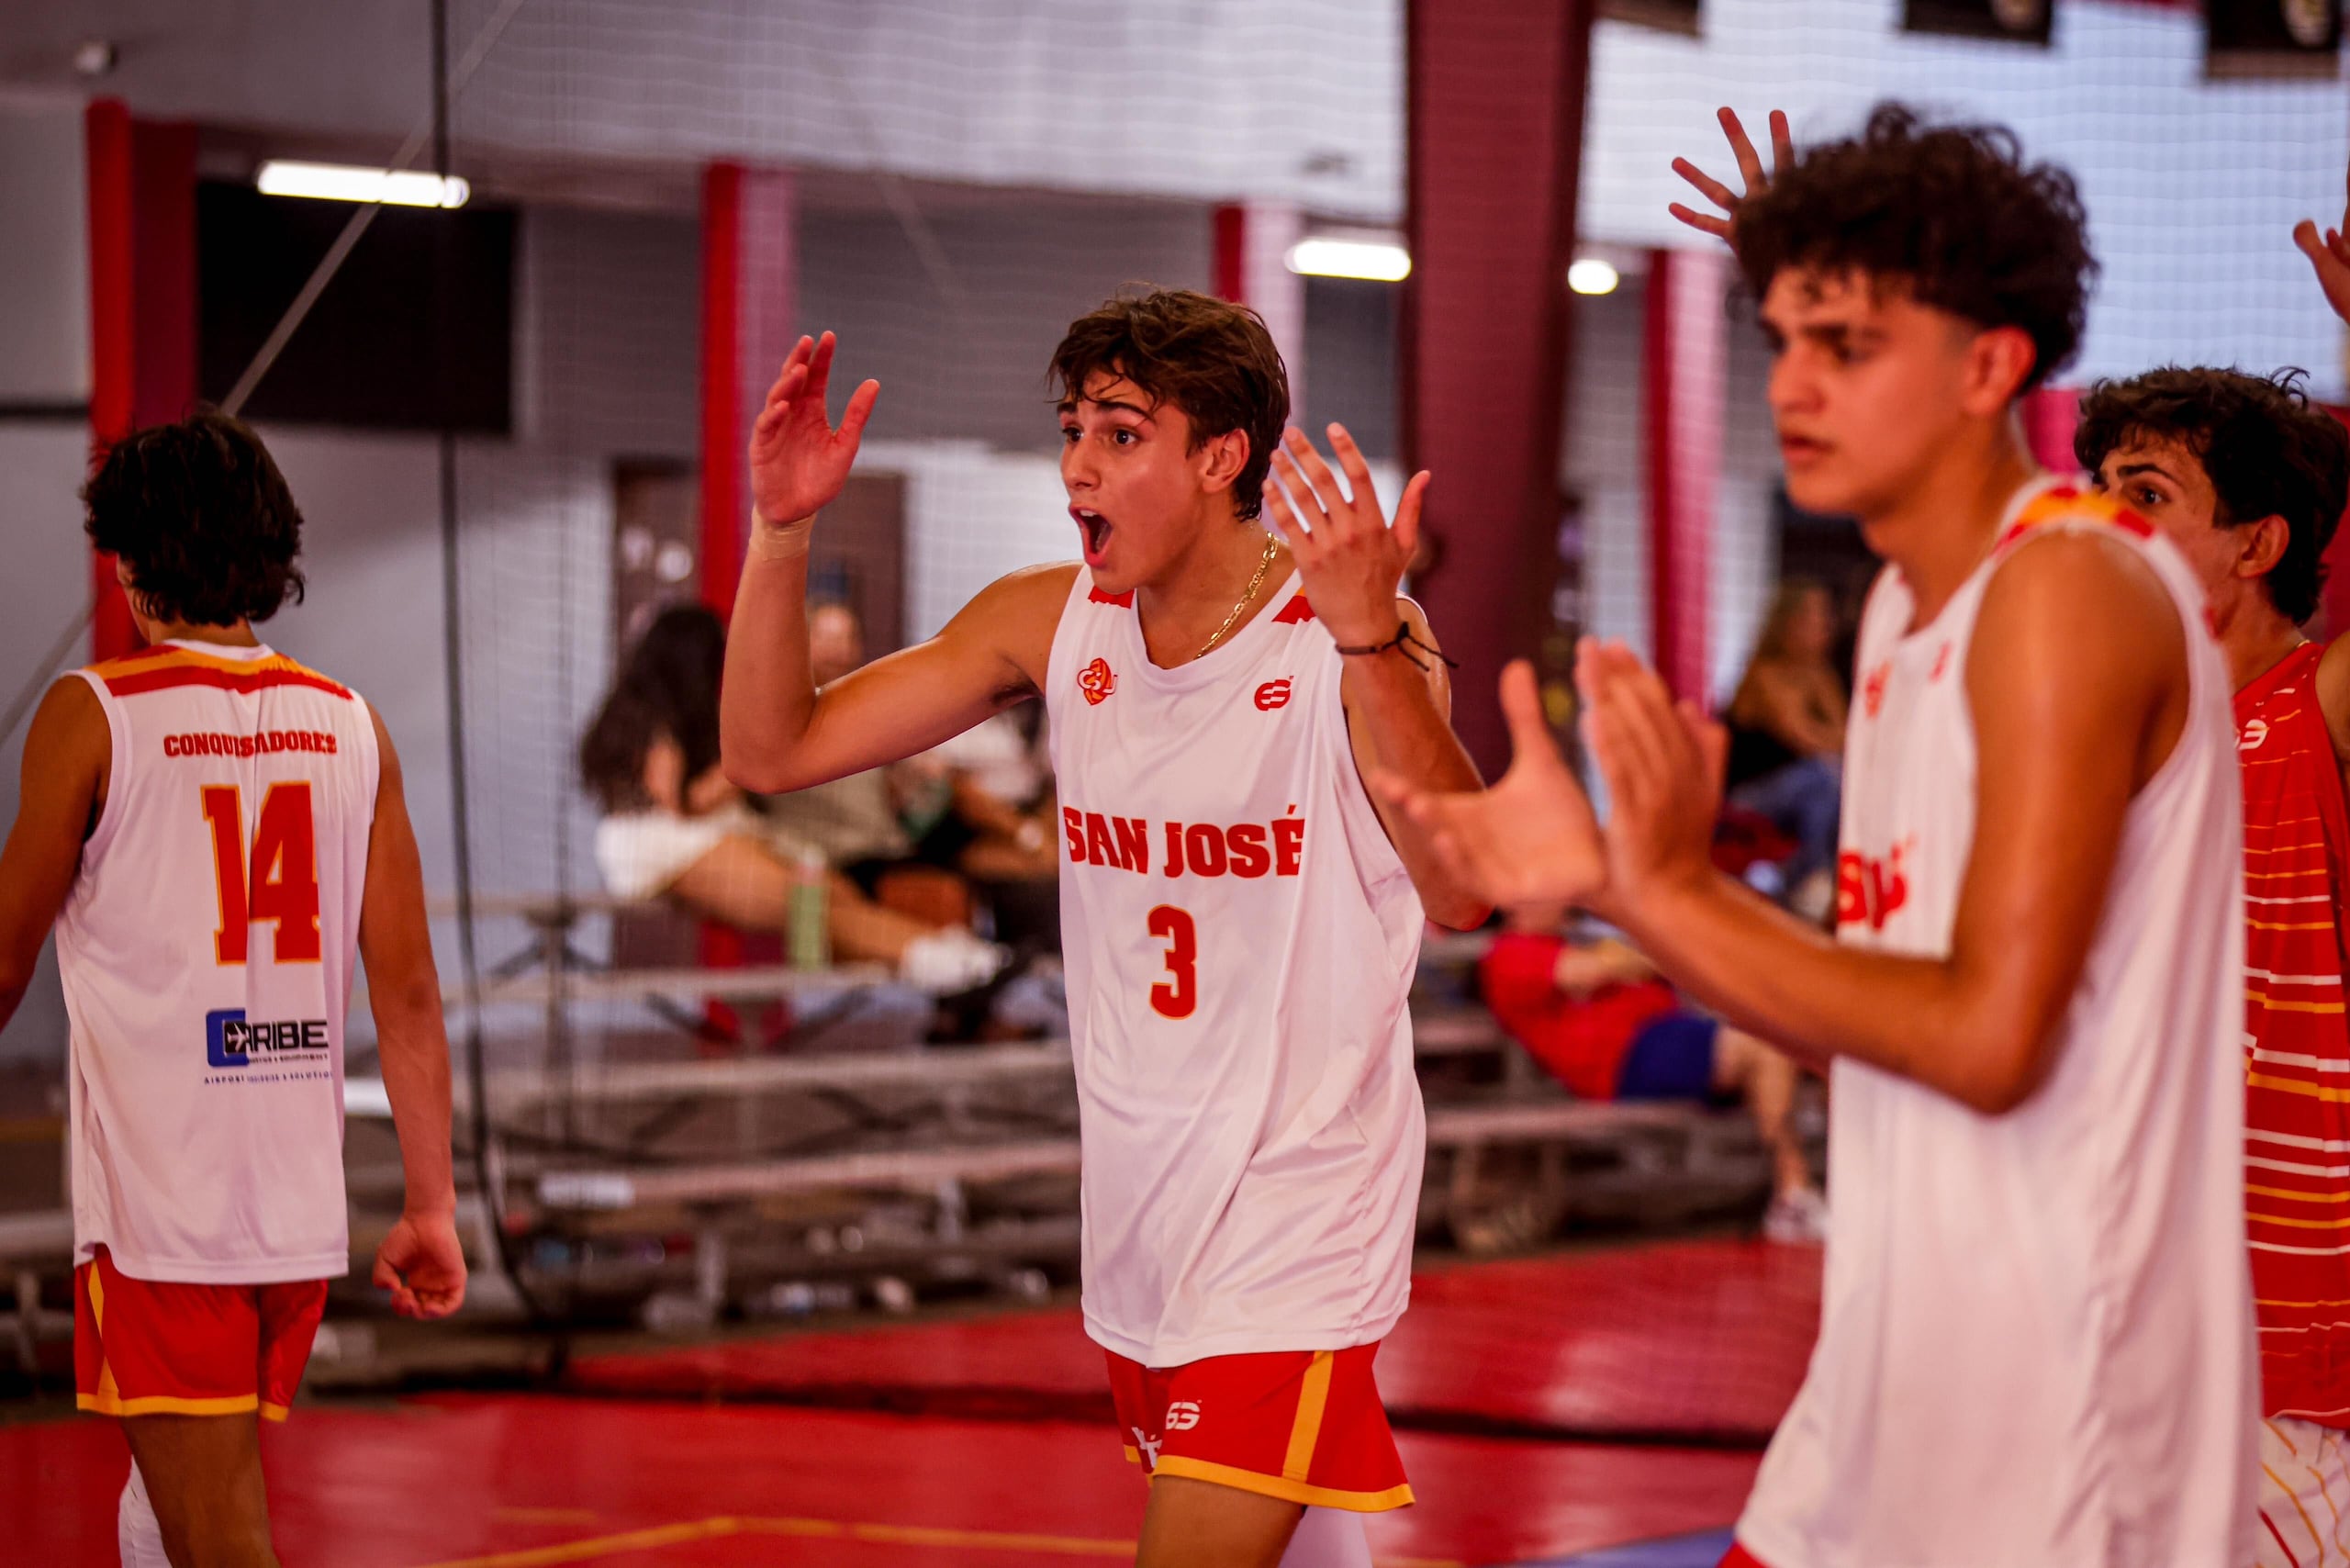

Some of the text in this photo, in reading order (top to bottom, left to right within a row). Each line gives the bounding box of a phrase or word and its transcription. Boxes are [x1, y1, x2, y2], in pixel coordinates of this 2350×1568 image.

[163, 730, 337, 758] CONQUISADORES
[200, 779, 322, 967] 14
[1063, 804, 1305, 879] SAN JOSÉ
[1147, 903, 1198, 1020] 3
